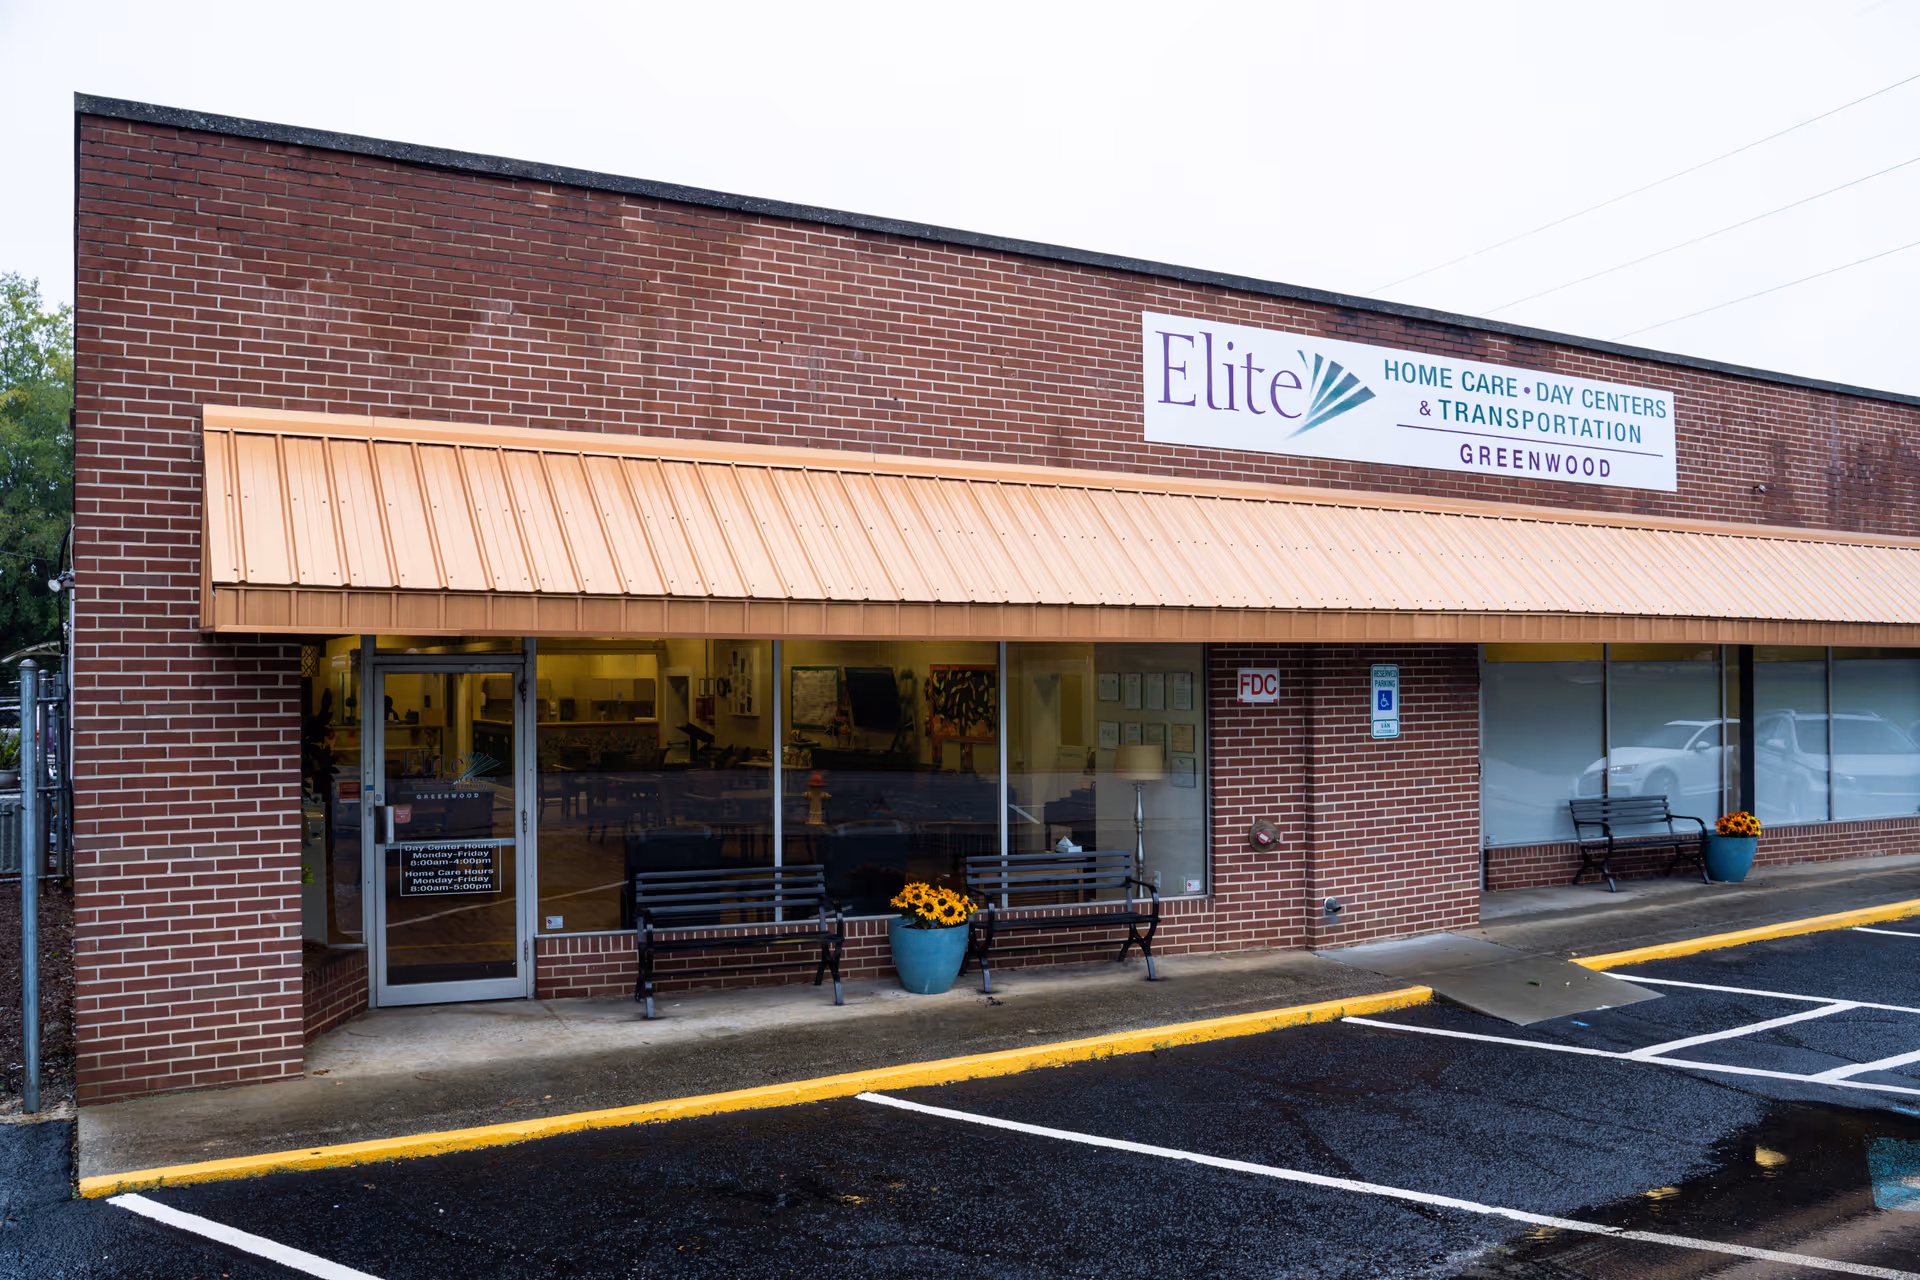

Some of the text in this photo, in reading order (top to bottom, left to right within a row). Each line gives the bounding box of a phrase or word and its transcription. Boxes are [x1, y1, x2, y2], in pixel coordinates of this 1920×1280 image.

[1155, 330, 1303, 420] Elite
[1384, 359, 1668, 419] HOME CARE DAY CENTERS
[1419, 399, 1643, 445] & TRANSPORTATION
[1459, 443, 1613, 478] GREENWOOD
[1373, 669, 1397, 678] RESERVED
[1240, 673, 1277, 696] FDC
[1374, 680, 1396, 688] PARKING
[416, 792, 480, 800] GREENWOOD
[404, 842, 497, 852] Day Center Hours:
[412, 850, 490, 859] Monday-Friday
[410, 857, 491, 866] 8:00am-4:00pm
[405, 870, 435, 878] Home
[437, 869, 461, 877] Care
[412, 875, 490, 885] Monday-Friday
[410, 882, 492, 892] 8:00am-5:00pm
